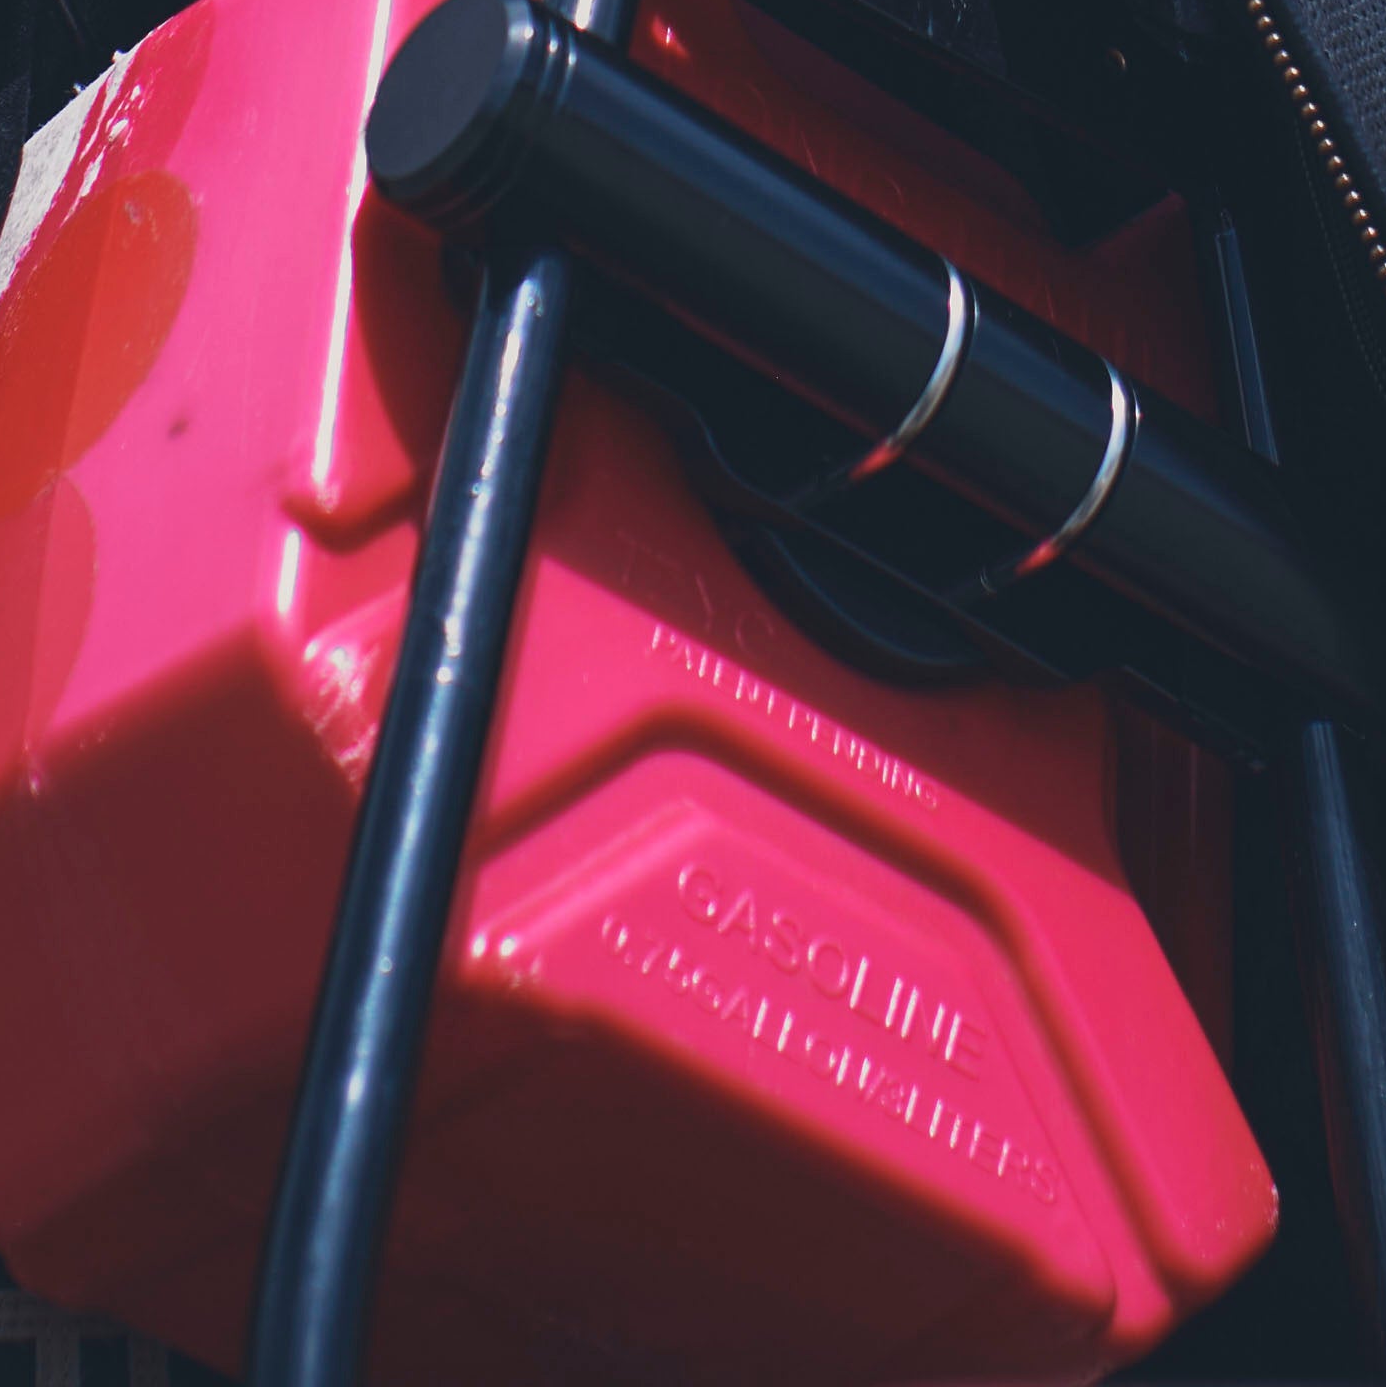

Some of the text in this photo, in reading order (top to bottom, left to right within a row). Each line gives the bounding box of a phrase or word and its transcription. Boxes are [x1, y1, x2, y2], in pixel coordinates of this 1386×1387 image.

[650, 623, 939, 810] PATENT PENDING
[677, 862, 987, 1083] GASOLINE
